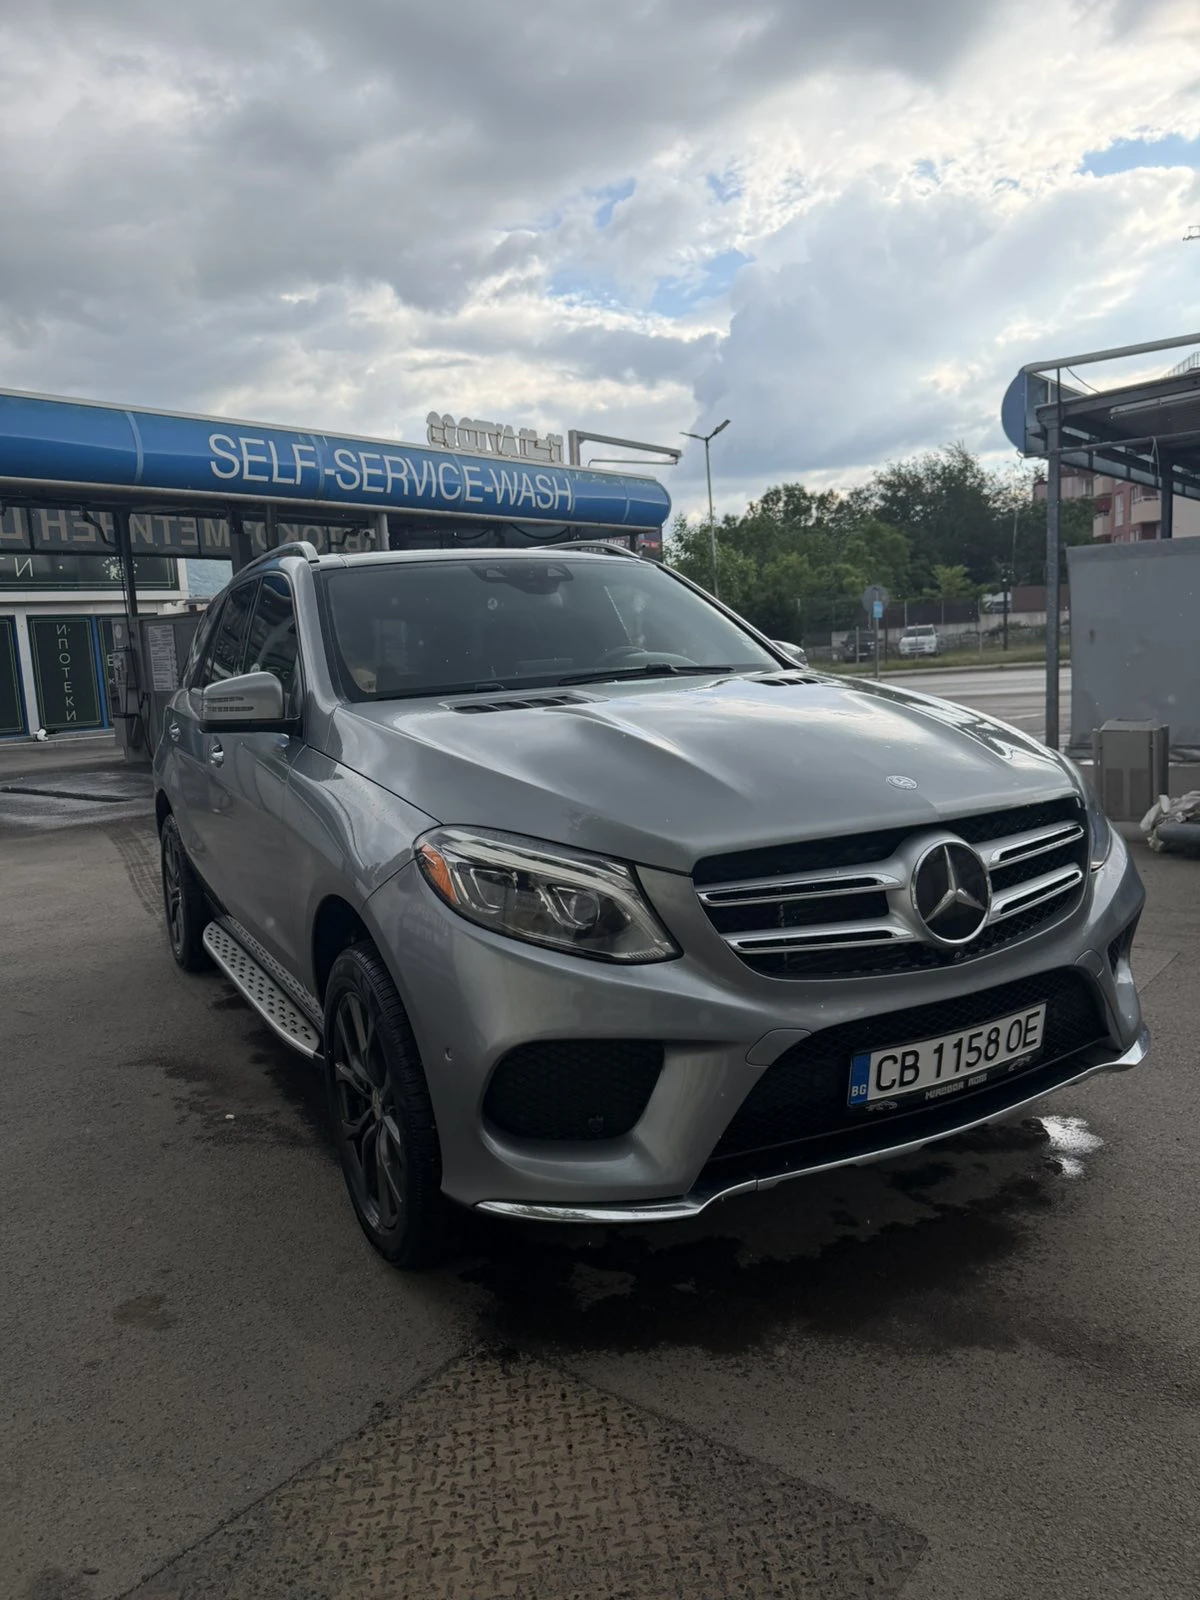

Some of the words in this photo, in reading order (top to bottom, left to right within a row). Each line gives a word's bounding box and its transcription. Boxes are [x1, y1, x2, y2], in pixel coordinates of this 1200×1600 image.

[56, 624, 77, 721] ИПОТЕКИ
[851, 1083, 867, 1097] BG
[875, 1049, 920, 1091] CB
[933, 1027, 1000, 1078] 1158
[1006, 1011, 1041, 1053] OE
